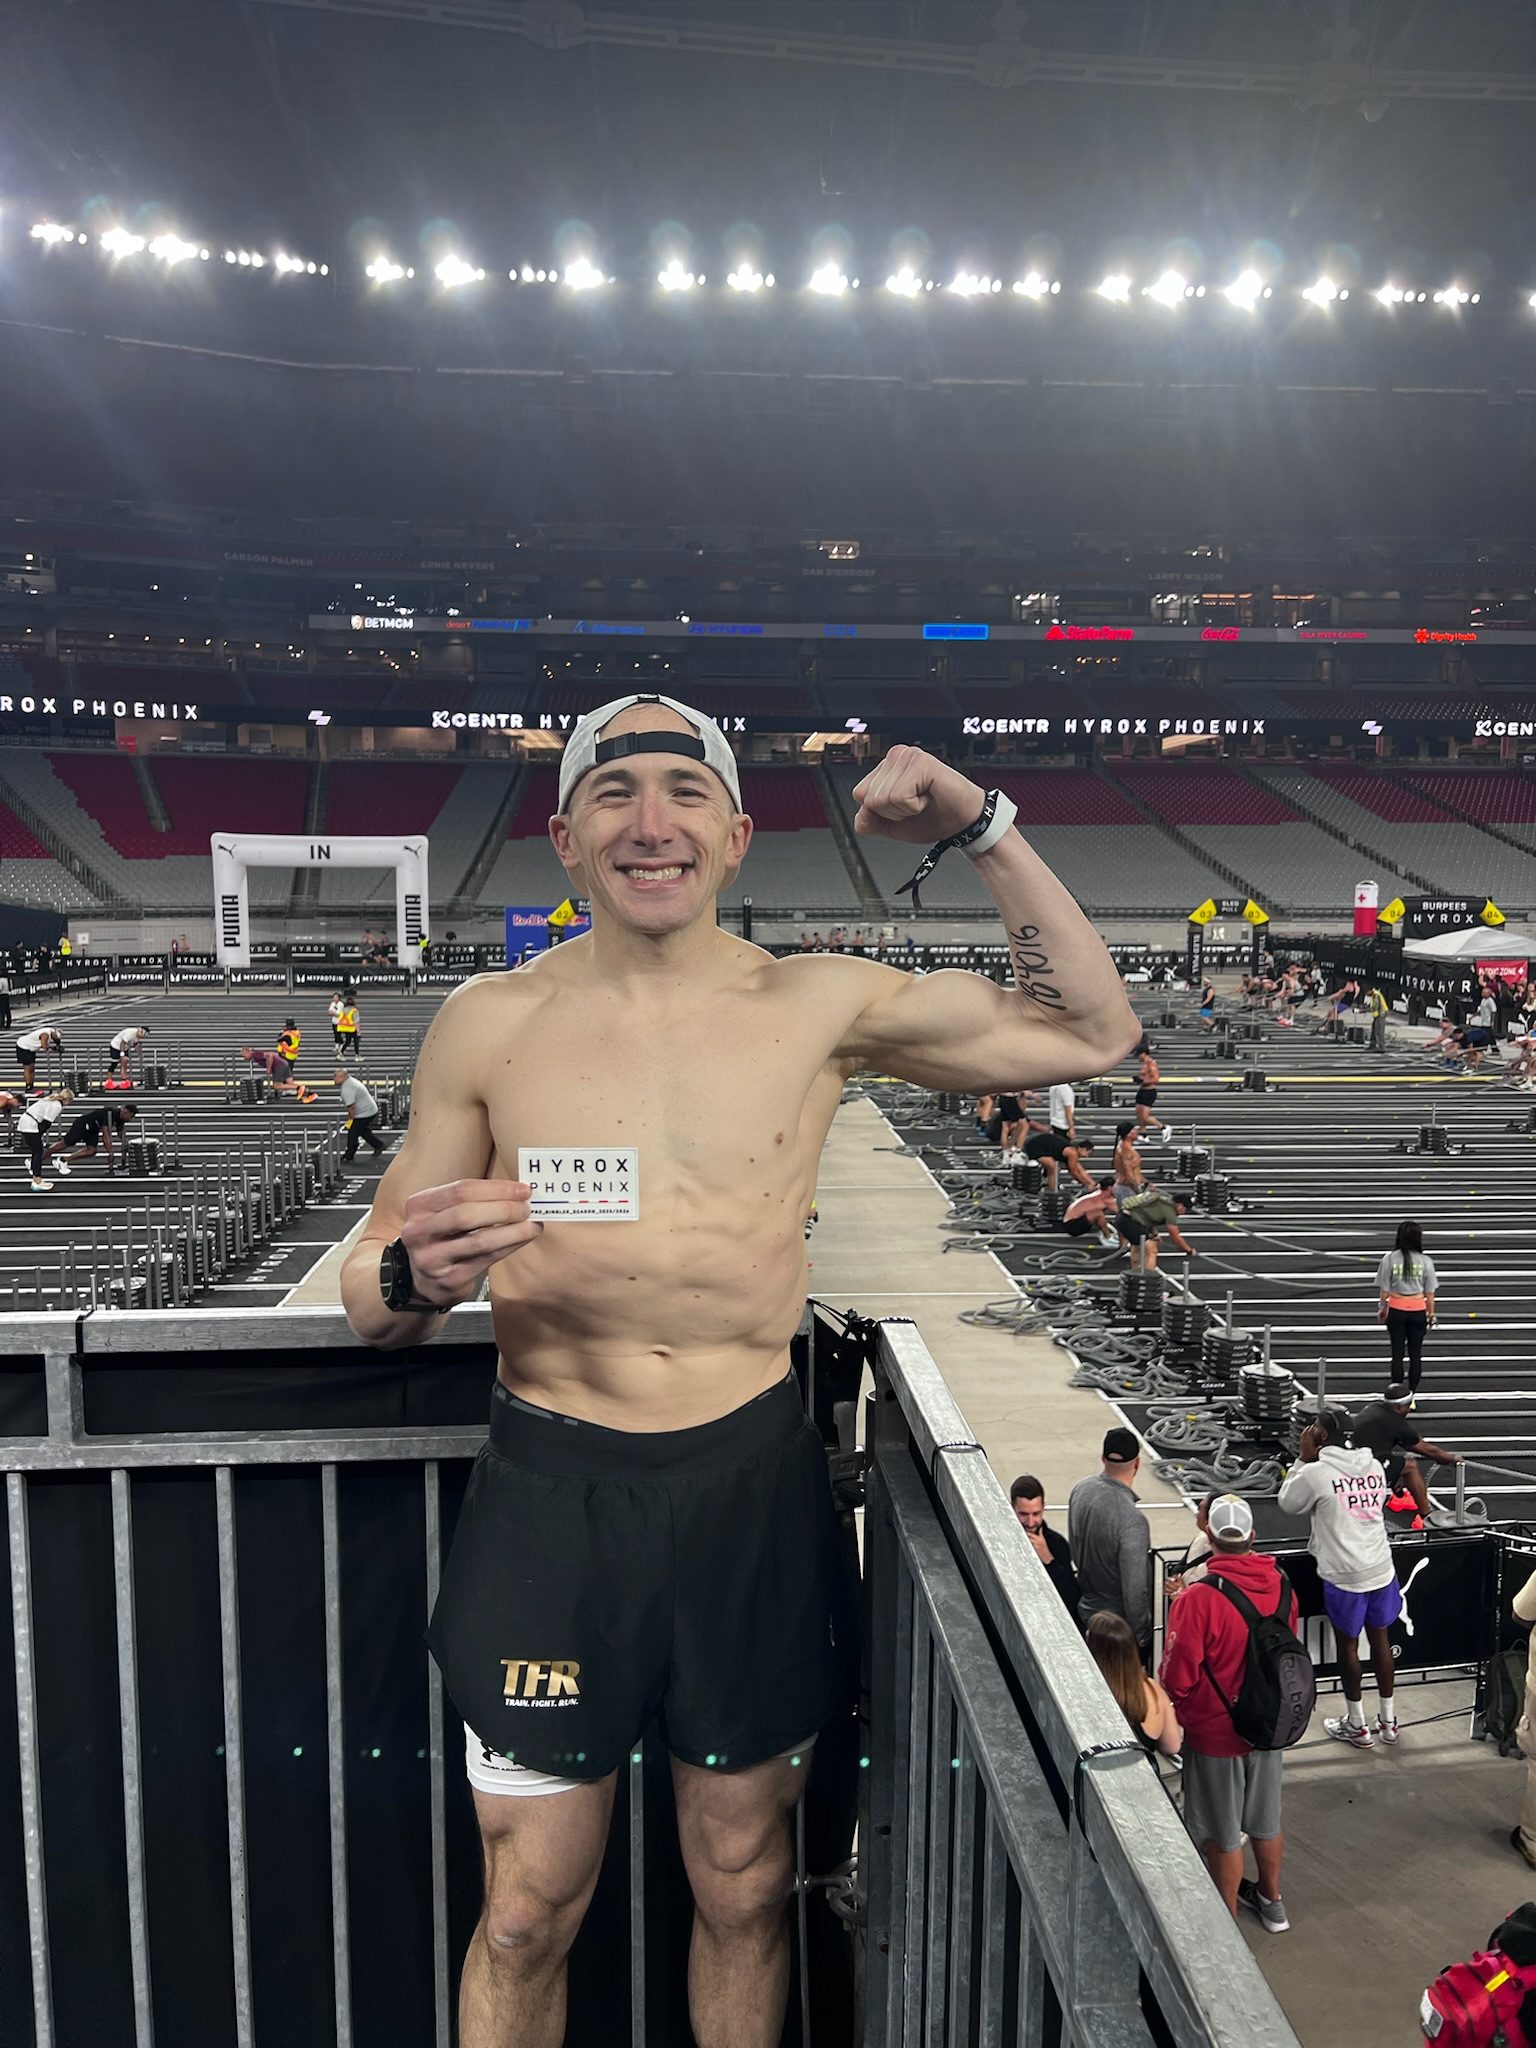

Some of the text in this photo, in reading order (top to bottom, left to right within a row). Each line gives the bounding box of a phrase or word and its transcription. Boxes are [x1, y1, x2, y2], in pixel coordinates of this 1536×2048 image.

[223, 551, 313, 567] CARSON PALMER
[364, 617, 414, 629] BETMGM
[1430, 632, 1477, 642] Dignity Health
[72, 699, 198, 721] PHOENIX
[1065, 718, 1147, 734] HYROX
[1159, 718, 1266, 735] PHOENIX
[1493, 720, 1536, 737] CEN
[310, 844, 331, 860] IN
[1422, 901, 1467, 911] BURPEES
[221, 894, 241, 948] PUMA
[404, 894, 422, 947] PUMA
[1413, 913, 1474, 924] HYROX
[66, 958, 108, 968] HYROX
[123, 957, 163, 966] HYROX
[176, 956, 208, 965] HYROX
[881, 956, 923, 964] HYROX
[935, 956, 975, 964] HYROX
[1129, 955, 1169, 964] HYROX
[1010, 925, 1067, 1011] 184016
[120, 972, 163, 981] MYPROTEIN
[181, 973, 224, 981] MYPROTEIN
[243, 973, 286, 982] MYPROTEIN
[306, 974, 344, 983] MYPROTEIN
[362, 974, 405, 983] MYPROTEIN
[529, 1158, 629, 1173] HYROX
[530, 1181, 629, 1193] PHOENIX
[245, 1247, 296, 1282] HYROX
[1331, 1473, 1386, 1495] HYROX
[1348, 1493, 1381, 1509] PHX
[500, 1658, 581, 1697] TFR
[505, 1698, 579, 1708] TRAIN. FIGHT. RUN.
